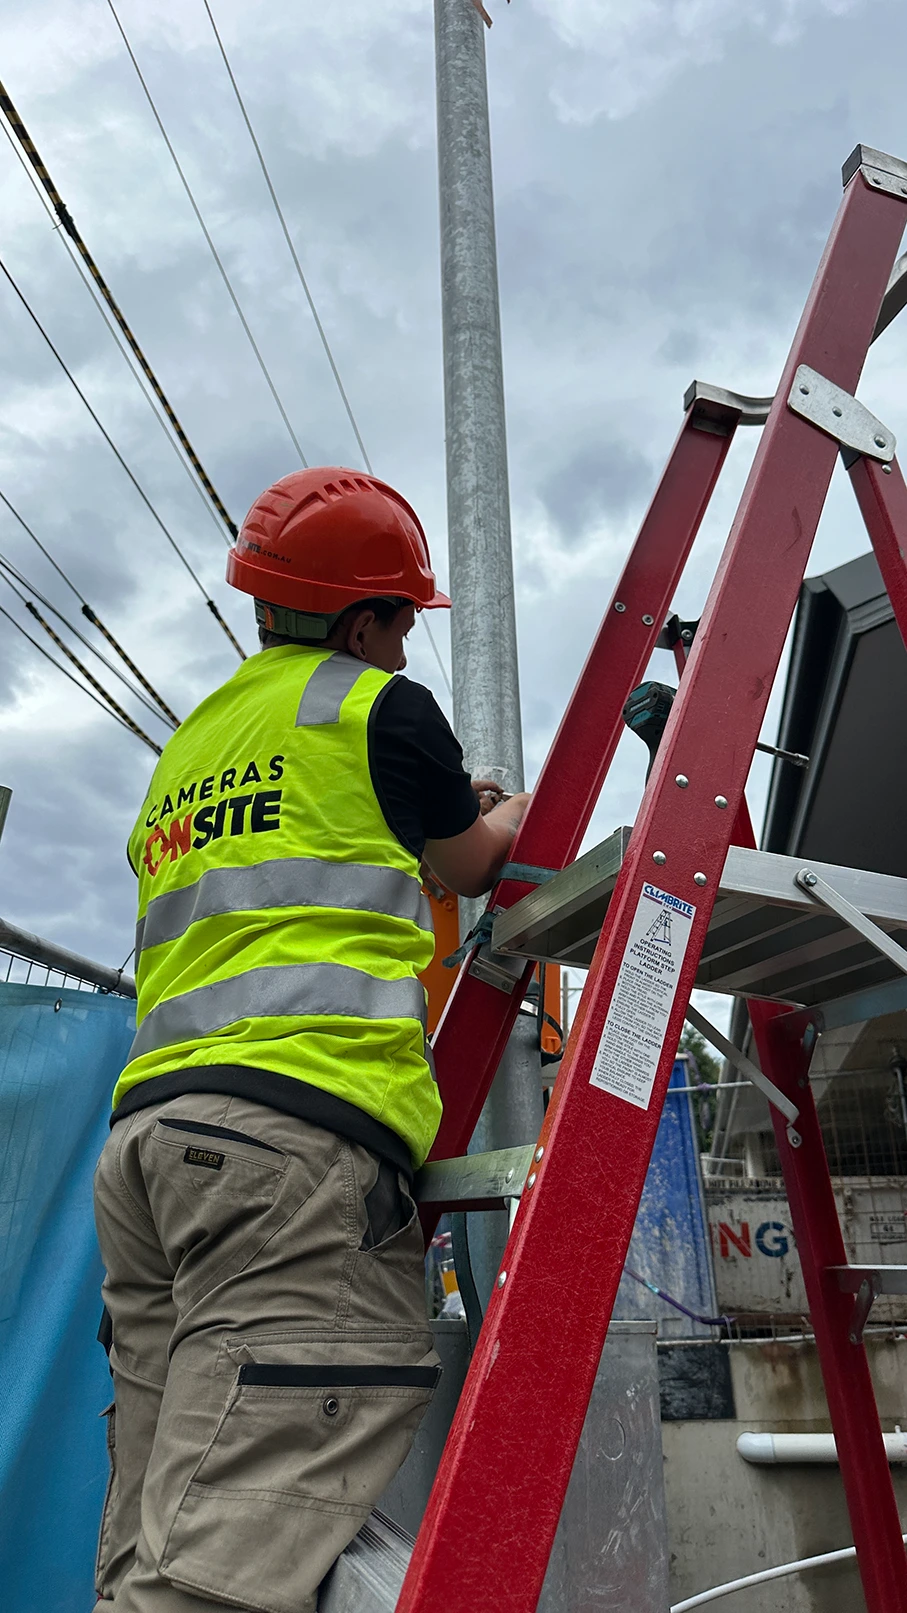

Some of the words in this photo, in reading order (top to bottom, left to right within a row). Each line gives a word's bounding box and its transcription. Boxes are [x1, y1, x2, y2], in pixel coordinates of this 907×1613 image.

[146, 754, 284, 828] CAMERAS
[634, 943, 674, 966] INSTRUCTIONS
[640, 938, 671, 957] OPERATING
[630, 948, 659, 966] PLATFORM
[661, 963, 675, 974] STEP
[639, 960, 662, 975] LADDER
[630, 965, 643, 974] OPEN
[654, 977, 673, 989] LADDER
[615, 1024, 631, 1034] CLOSE
[642, 1037, 661, 1049] LADDER
[710, 1221, 788, 1258] NG
